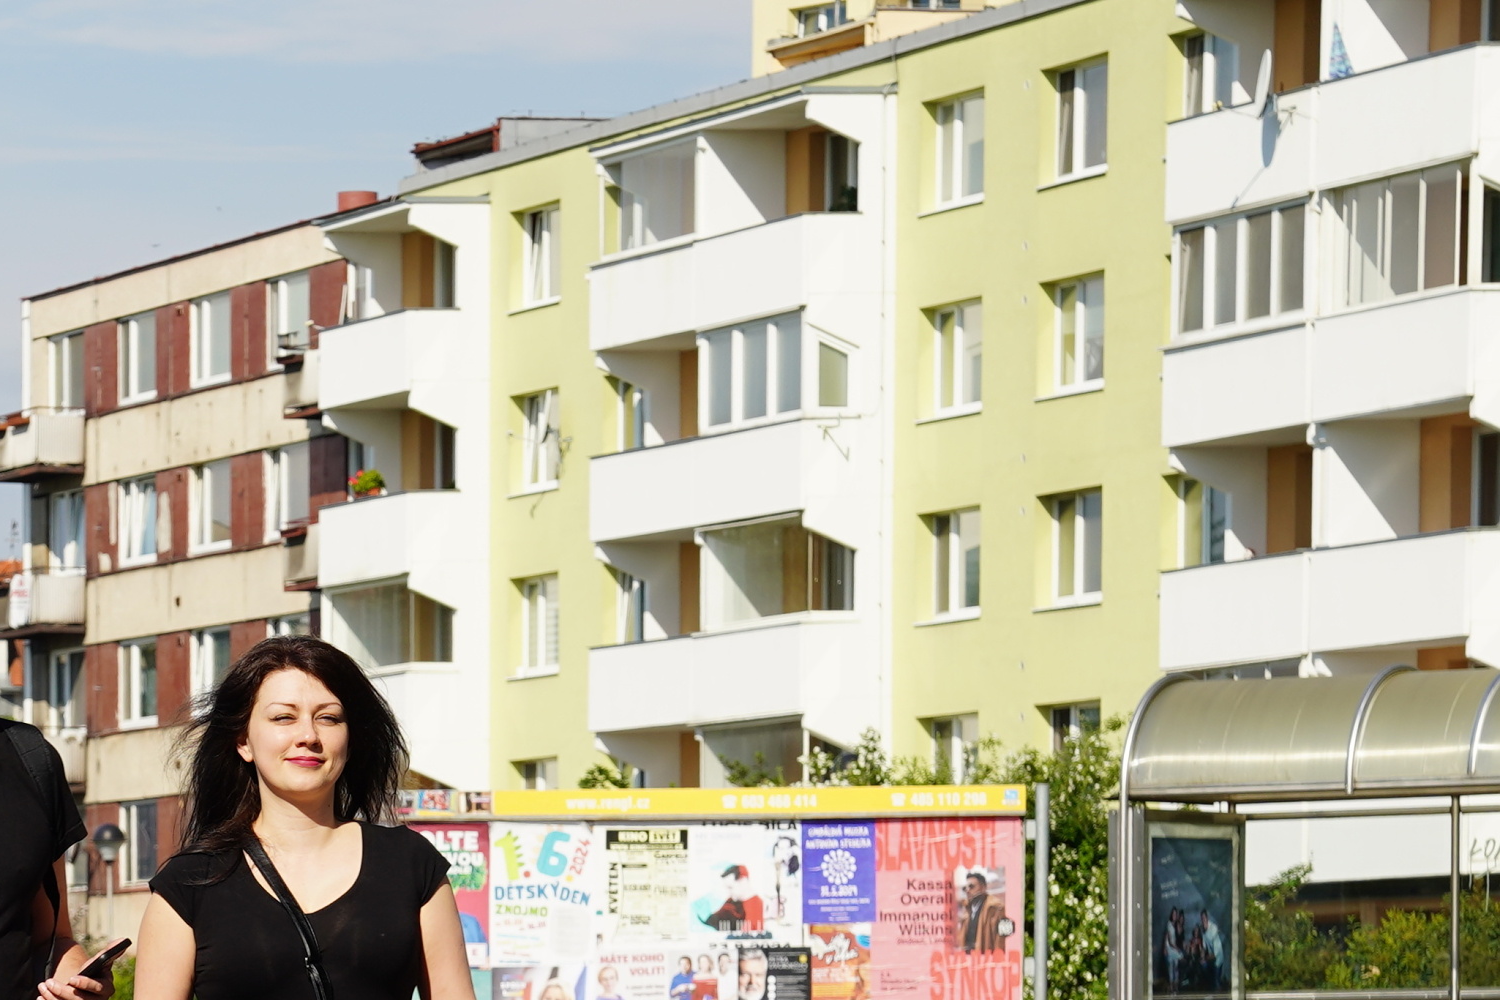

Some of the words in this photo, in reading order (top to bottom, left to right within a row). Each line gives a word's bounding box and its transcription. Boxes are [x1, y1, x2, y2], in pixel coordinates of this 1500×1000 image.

[618, 831, 648, 842] KINO
[570, 838, 592, 876] 2024
[906, 879, 953, 891] Kassa
[900, 893, 953, 905] Overall
[495, 904, 548, 917] ZNOJMO
[879, 910, 953, 922] Immanuel
[899, 924, 953, 936] Wilkins
